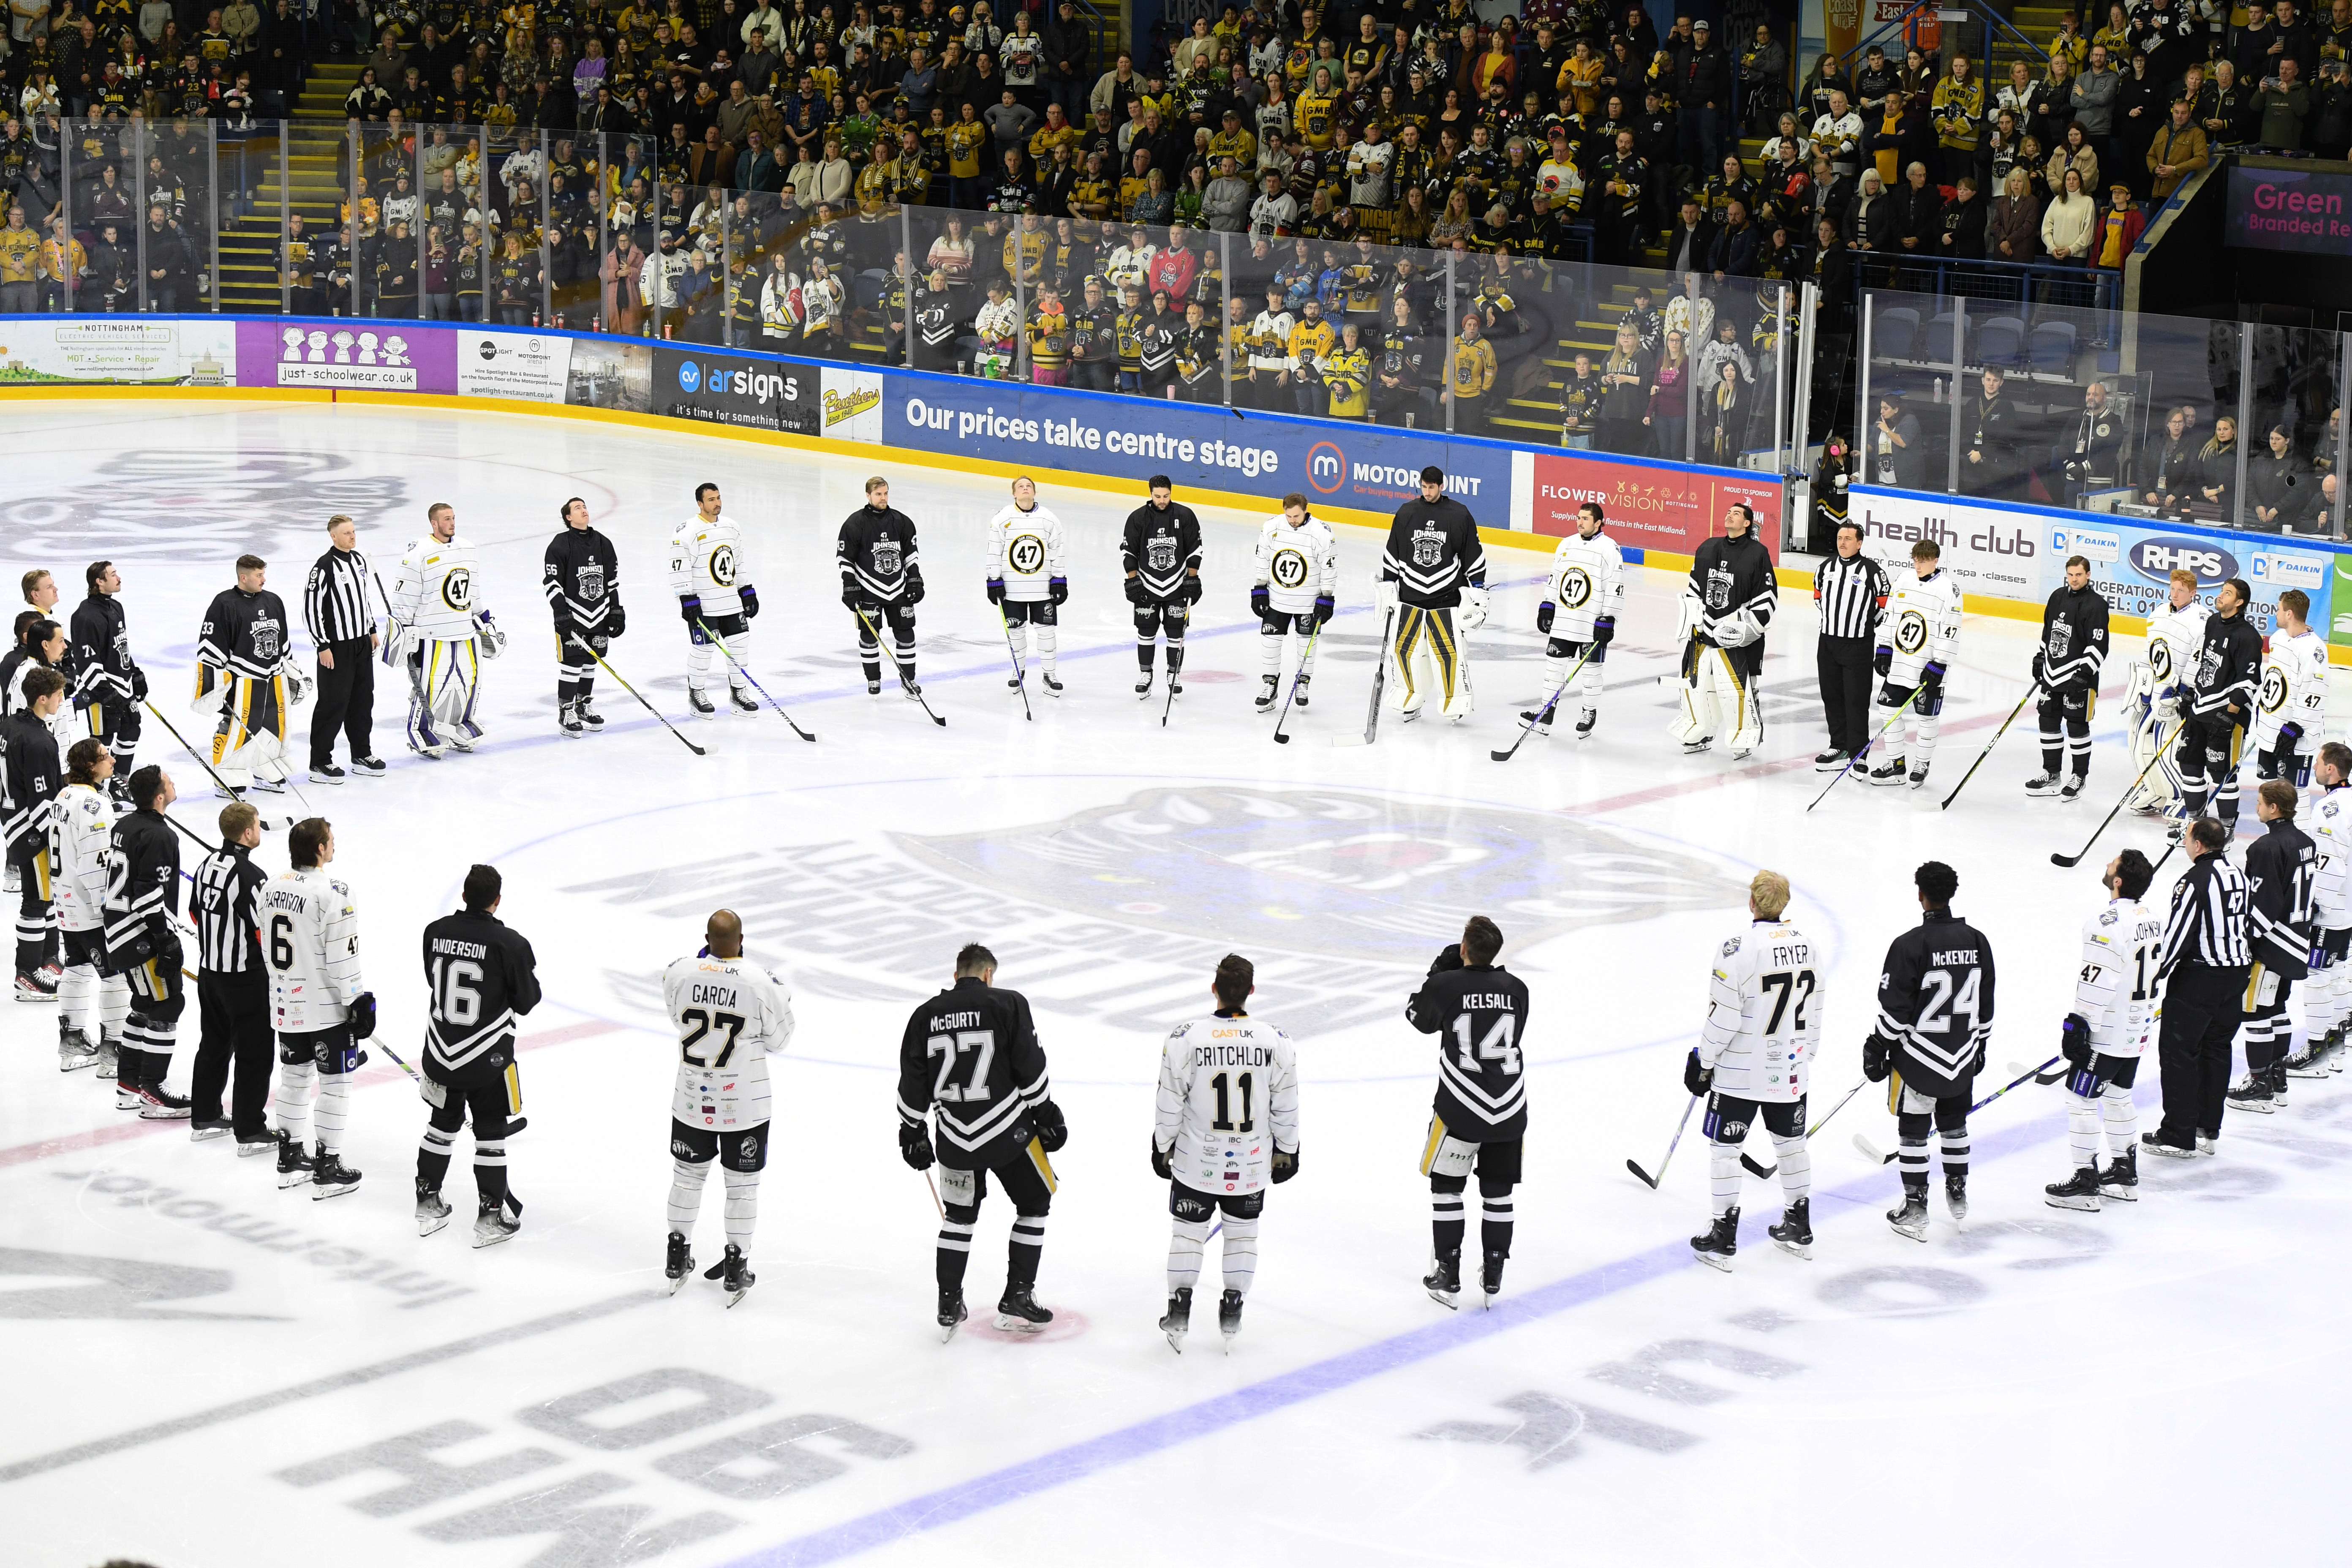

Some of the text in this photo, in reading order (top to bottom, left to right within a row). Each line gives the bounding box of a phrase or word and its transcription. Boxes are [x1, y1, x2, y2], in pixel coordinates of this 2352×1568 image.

[1948, 89, 1966, 97] GMB
[2254, 184, 2342, 214] Green
[2250, 214, 2324, 234] Branded
[1524, 240, 1544, 249] GMB
[135, 355, 160, 364] Repair
[282, 368, 413, 383] just-schoolwear.co.uk
[471, 387, 554, 398] spotlight-restaurant.co.uk
[709, 366, 798, 404] arsigns
[823, 387, 880, 414] Panthers
[677, 404, 800, 430] it's time for something new
[828, 408, 853, 424] Since 1946
[906, 399, 1279, 477] Our prices take centre stage
[1353, 463, 1481, 496] MOTORINT
[1368, 487, 1393, 499] buying
[1394, 491, 1414, 500] made
[1724, 486, 1741, 495] PROUD
[1749, 489, 1773, 498] SPONSOR
[1666, 501, 1698, 509] NOTTINGHAM
[1174, 519, 1179, 528] A
[1606, 518, 1625, 528] florists
[1633, 521, 1642, 530] the
[1644, 523, 1657, 532] East
[1658, 525, 1686, 535] Midlands
[1411, 530, 1447, 543] JOHNSON
[1866, 510, 2035, 557] health club
[2084, 537, 2117, 547] DAIKIN
[871, 541, 901, 553] JOHNSON
[1147, 537, 1177, 548] JOHNSON
[1017, 546, 1037, 563] 47
[2076, 550, 2095, 558] Premium
[2142, 544, 2221, 577] RHPS
[546, 564, 557, 575] 56
[672, 559, 682, 571] 47
[1279, 560, 1298, 578] 47
[2286, 563, 2320, 574] DAIKIN
[452, 580, 468, 599] 47
[1565, 579, 1583, 598] 47
[201, 621, 214, 635] 33
[250, 619, 280, 634] JOHNSON
[1901, 622, 1920, 642] 47
[1944, 627, 1957, 638] 47
[2092, 628, 2104, 641] 98
[2247, 662, 2255, 674] 2
[2263, 679, 2279, 700] 47
[2305, 695, 2321, 708] 47
[34, 775, 48, 792] 61
[156, 866, 171, 882] 32
[280, 873, 308, 884] CASTUK
[203, 887, 221, 910] 47
[264, 890, 307, 915] HARRISON
[2228, 891, 2243, 913] 47
[270, 912, 294, 972] 6
[1769, 930, 1802, 939] CASTUK
[432, 938, 486, 960] ANDERSON
[1773, 945, 1808, 967] FRYER
[1933, 950, 1978, 966] McKENZIE
[699, 963, 740, 976] CASTUK
[2080, 965, 2102, 983] 47
[432, 956, 484, 1026] 16
[693, 984, 737, 1008] GARCIA
[1914, 967, 1982, 1032] 24
[1463, 993, 1514, 1010] KELSALL
[1760, 967, 1816, 1037] 72
[931, 1011, 980, 1032] McGURTY
[681, 1007, 748, 1070] 27
[1212, 1029, 1253, 1039] CASTUK
[1452, 1013, 1521, 1075] 14
[1195, 1046, 1273, 1067] CRITCHLOW
[927, 1030, 995, 1102] 27
[1210, 1070, 1255, 1134] 11
